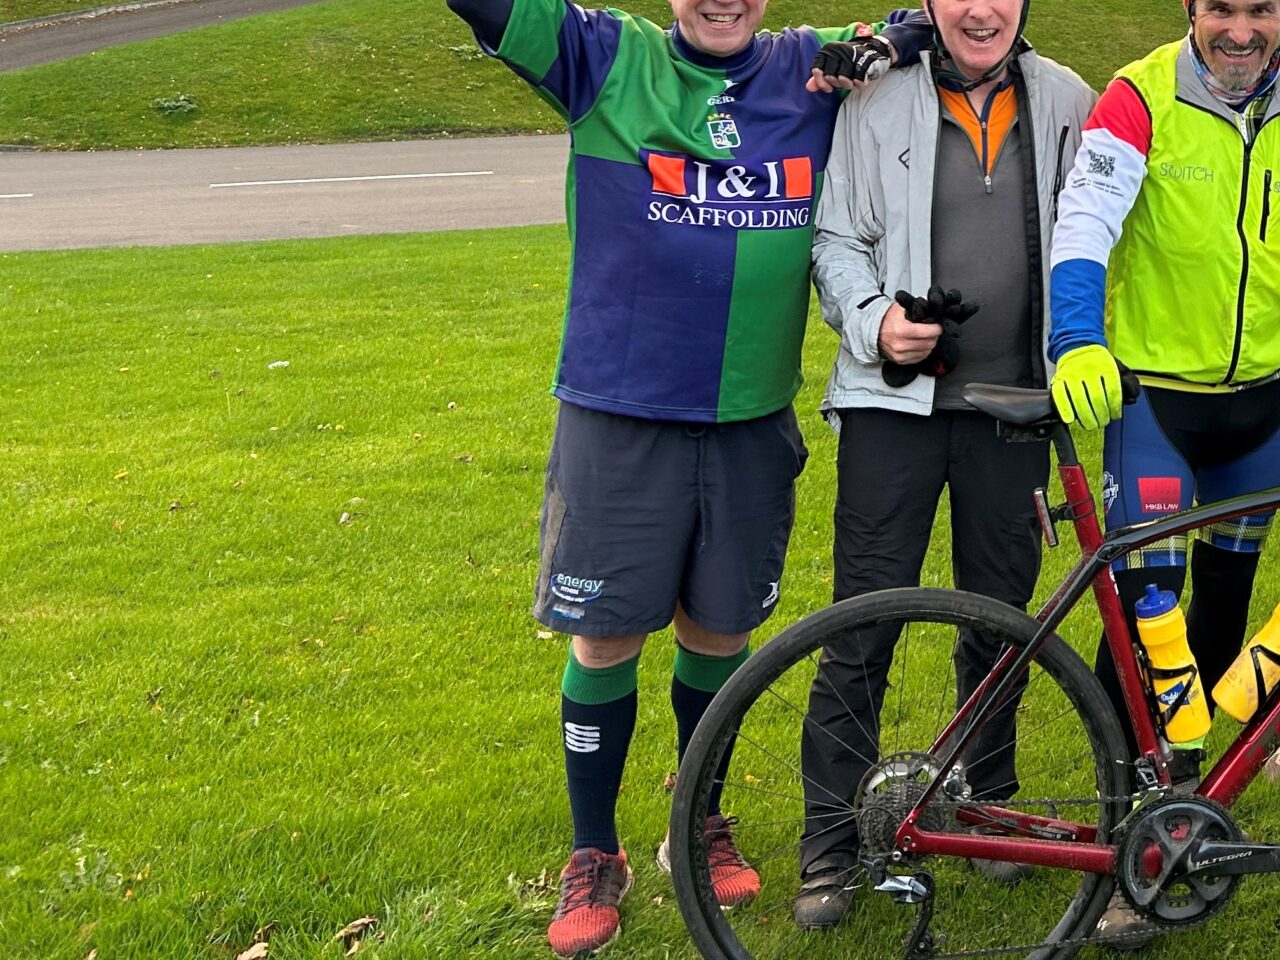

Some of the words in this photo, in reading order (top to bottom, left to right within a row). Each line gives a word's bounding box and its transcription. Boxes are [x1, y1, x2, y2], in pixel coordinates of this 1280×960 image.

[1160, 162, 1215, 182] SWITCH
[648, 201, 809, 228] SCAFFOLDING
[557, 573, 604, 594] energy
[1196, 850, 1253, 867] ULTEGRA
